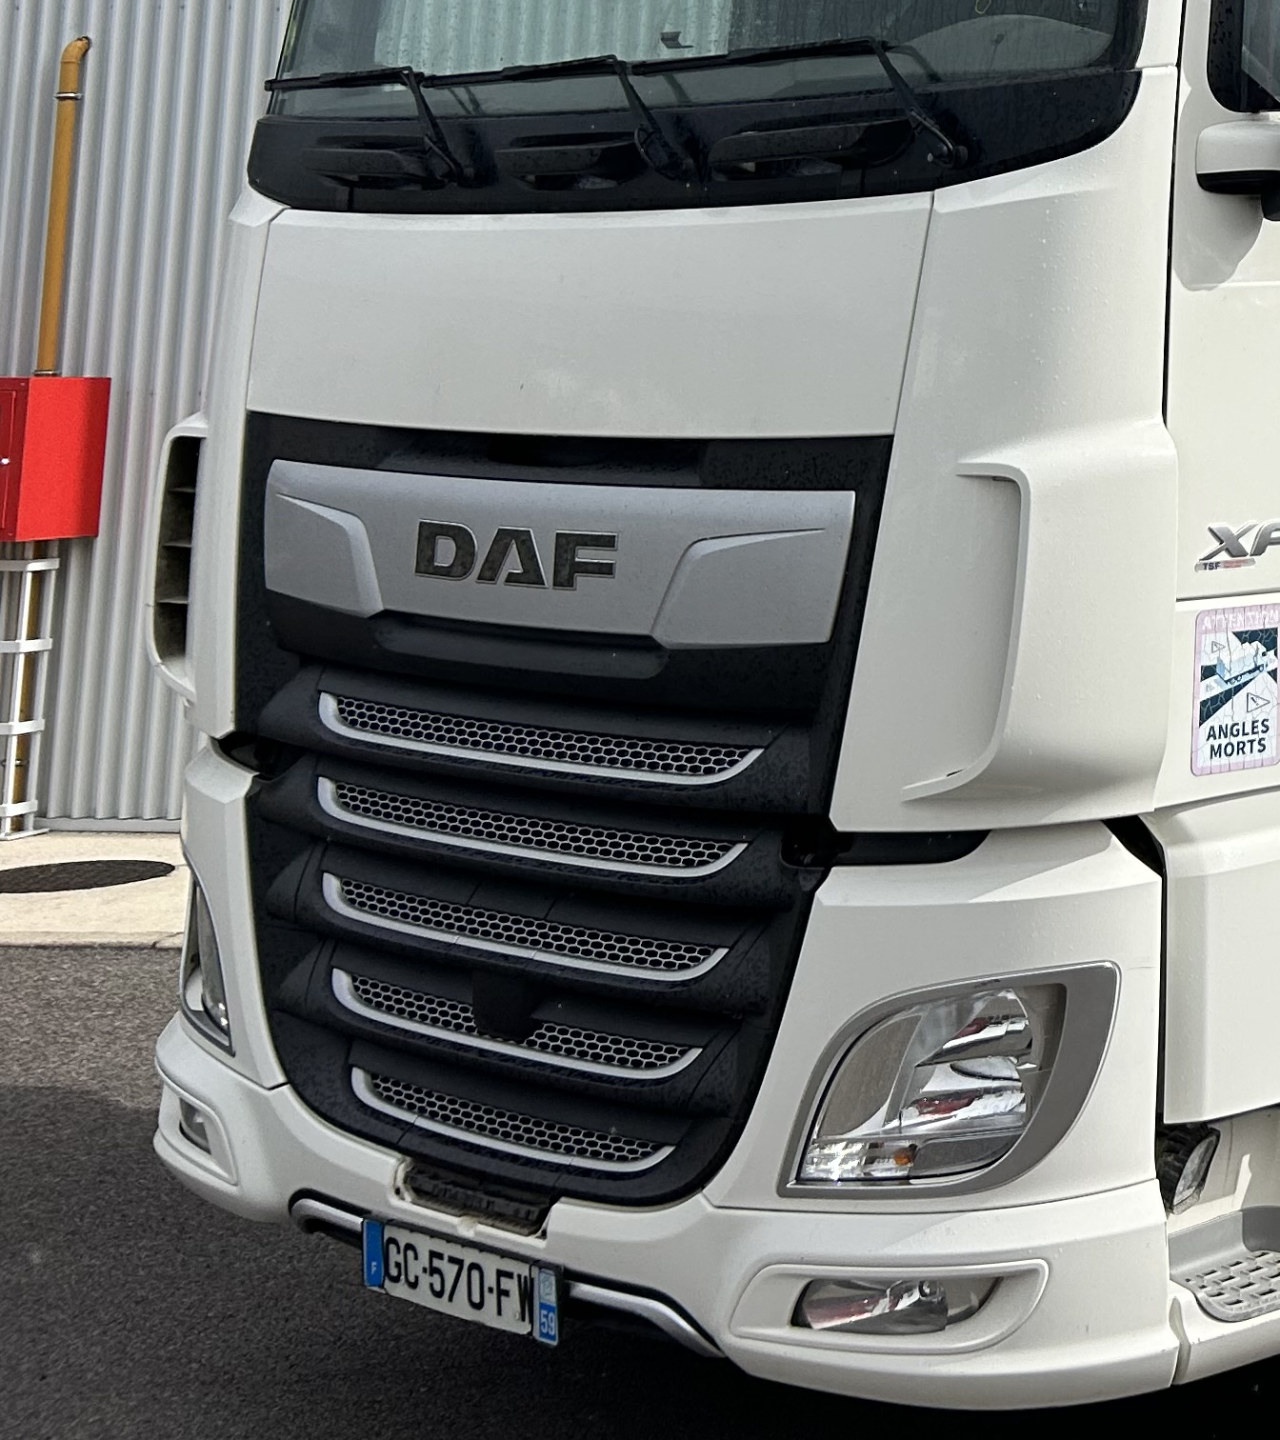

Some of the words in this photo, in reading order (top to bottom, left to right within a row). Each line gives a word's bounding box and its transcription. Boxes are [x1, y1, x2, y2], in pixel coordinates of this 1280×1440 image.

[414, 518, 618, 591] DAF
[1206, 718, 1270, 742] ANGLES
[1209, 737, 1267, 760] MORTS
[539, 1312, 557, 1336] 59
